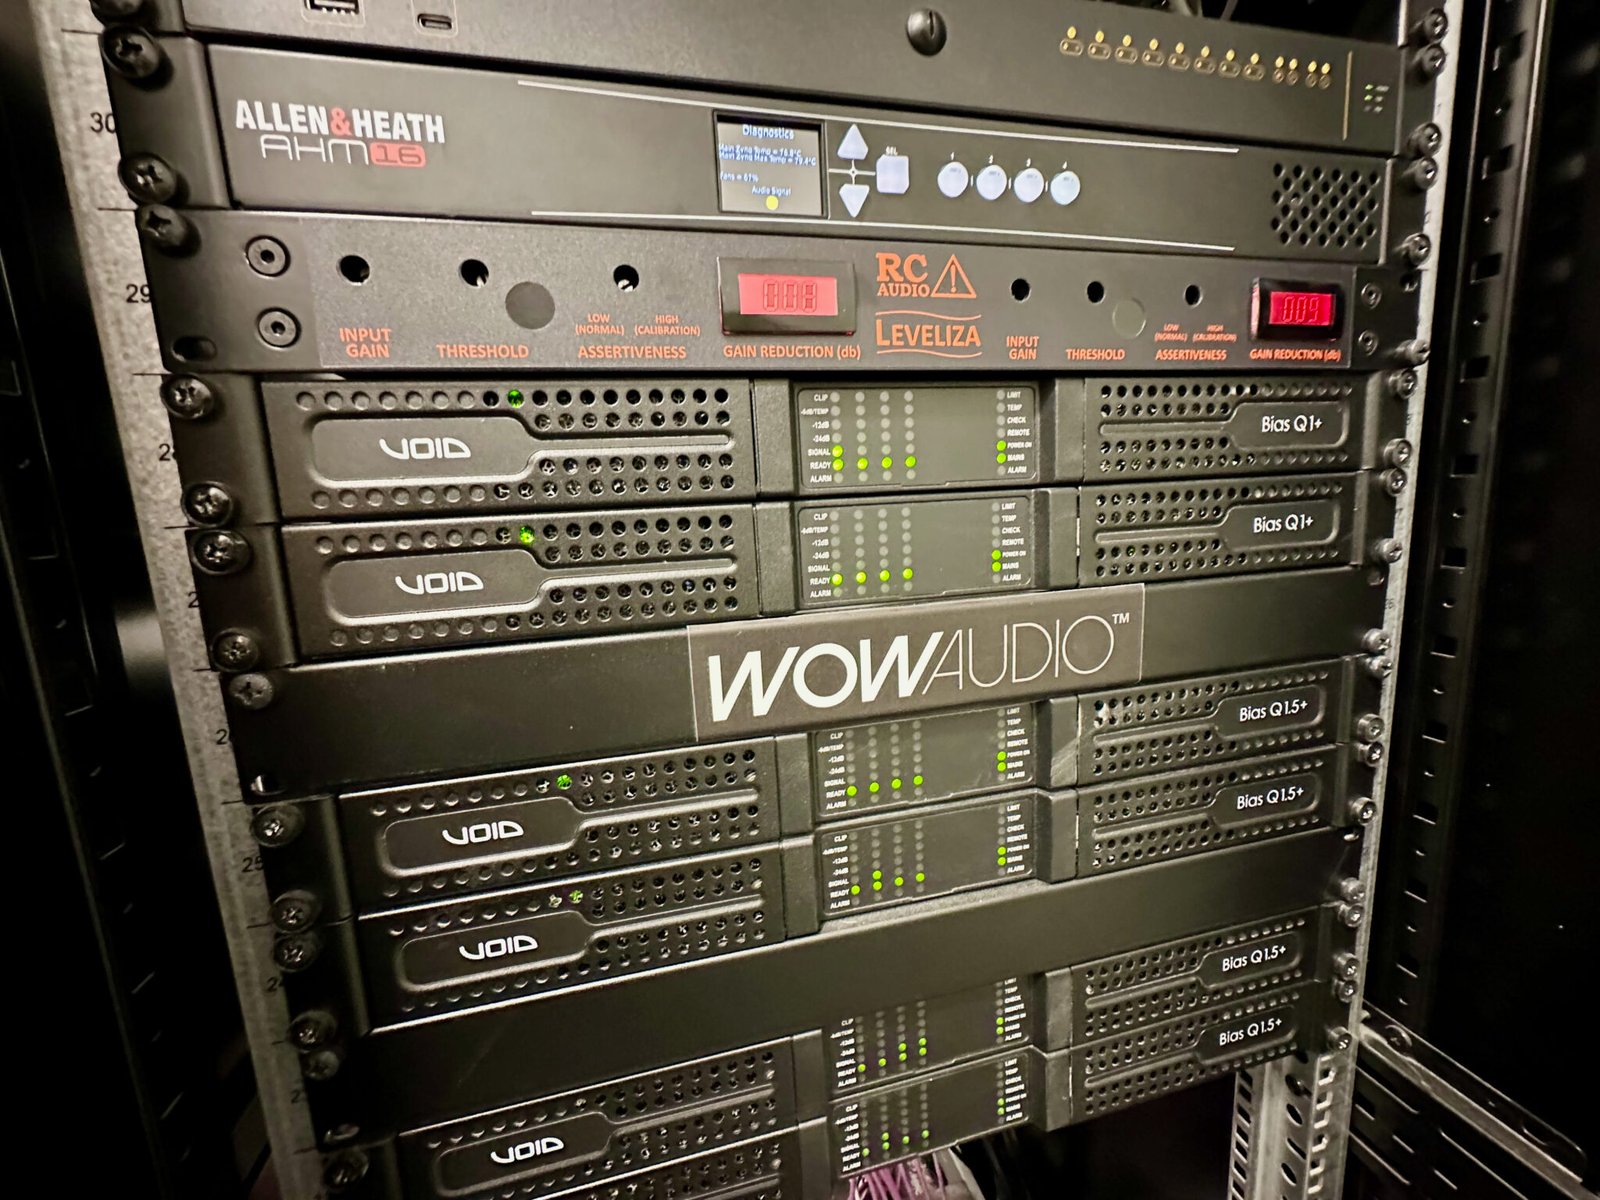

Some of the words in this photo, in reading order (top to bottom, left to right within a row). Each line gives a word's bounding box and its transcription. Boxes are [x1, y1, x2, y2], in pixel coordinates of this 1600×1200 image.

[235, 99, 446, 144] ALLEN&HEATH
[742, 123, 795, 140] Diagnostics
[876, 252, 928, 283] RC
[877, 283, 930, 297] AUDIO
[588, 313, 610, 323] LOW
[655, 314, 679, 324] HIGH
[339, 327, 391, 342] INPUT
[575, 324, 625, 336] (NORMAL)
[634, 325, 701, 337] (CALIBRATION)
[876, 319, 982, 347] LEVELIZA
[1006, 335, 1040, 348] INPUT
[346, 343, 390, 358] GAIN
[436, 344, 529, 359] THRESHOLD
[578, 345, 687, 359] ASSERTIVENESS
[723, 345, 757, 358] GAIN
[760, 345, 834, 358] REDUCTION
[837, 345, 861, 361] (db)
[1008, 348, 1037, 360] GAIN
[1066, 348, 1126, 361] THRESHOLD
[1155, 349, 1227, 360] ASSERTIVENESS
[1250, 348, 1273, 359] GAIN
[1274, 349, 1323, 360] REDUCTION
[814, 394, 828, 402] CLIP
[1007, 416, 1026, 424] CHECK
[1261, 415, 1290, 432] Bias
[379, 437, 471, 460] VOID
[808, 448, 831, 456] SIGNAL
[810, 461, 831, 469] READY
[810, 475, 832, 483] ALARM
[1253, 516, 1282, 533] Bias
[808, 564, 830, 572] SIGNAL
[395, 572, 484, 595] VOID
[810, 577, 831, 585] READY
[810, 589, 831, 598] ALARM
[1240, 706, 1267, 722] Bias
[826, 789, 846, 798] READY
[826, 801, 847, 810] ALARM
[1237, 794, 1264, 810] Bias
[442, 820, 524, 845] VOID
[834, 834, 847, 842] CLIP
[830, 900, 850, 909] ALARM
[459, 935, 538, 960] VOID
[1222, 956, 1248, 972] Bias
[1219, 1029, 1245, 1046] Bias
[490, 1137, 564, 1164] VOID
